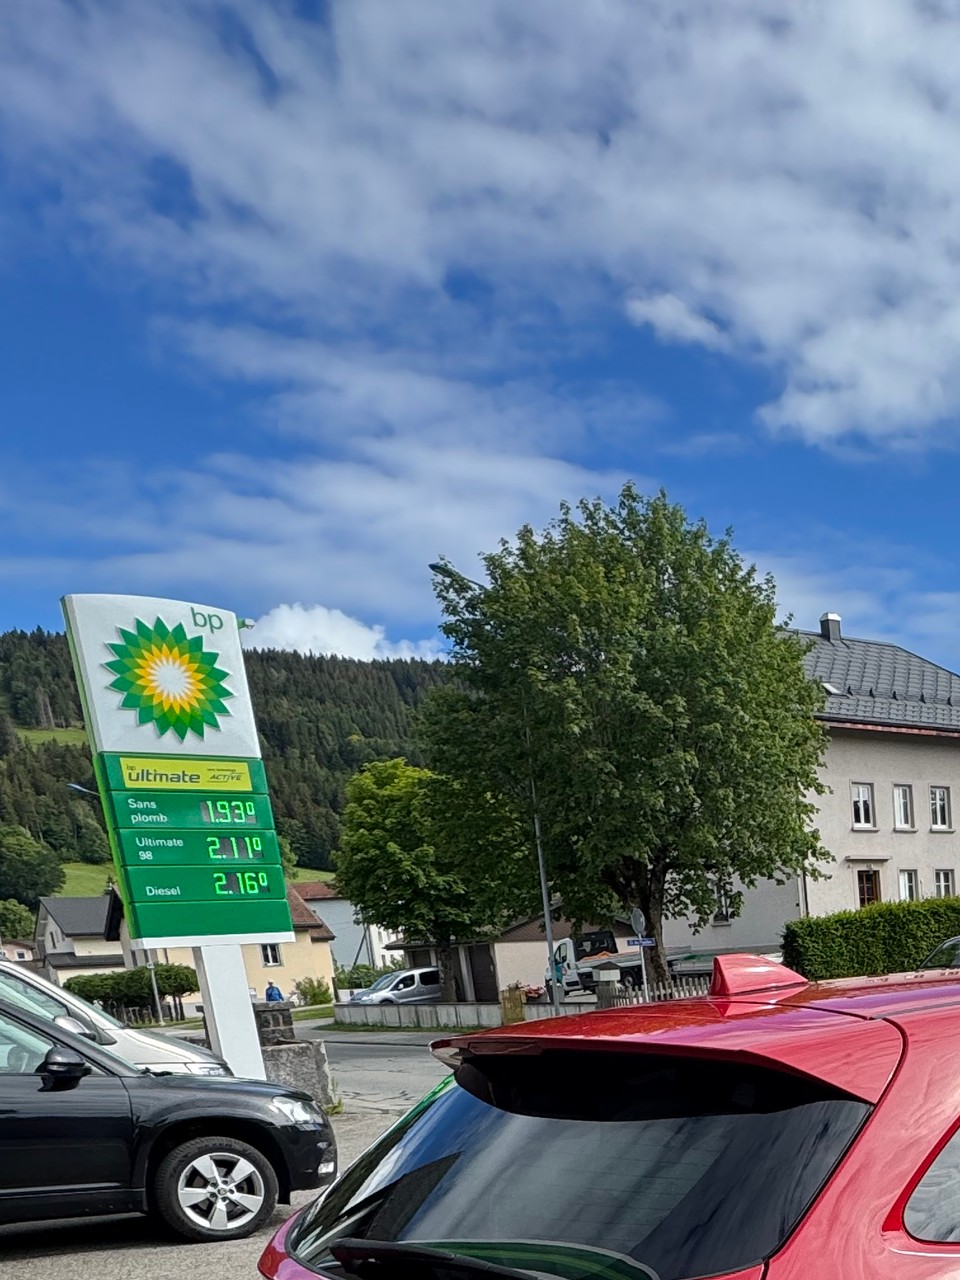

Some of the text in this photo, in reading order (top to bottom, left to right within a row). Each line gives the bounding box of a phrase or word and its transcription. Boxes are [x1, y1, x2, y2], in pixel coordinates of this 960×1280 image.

[190, 607, 224, 635] bp
[127, 768, 201, 784] ultimate
[209, 773, 243, 781] ACTIVE
[127, 798, 157, 809] Sans
[130, 812, 168, 825] plomb
[135, 837, 184, 847] Ultimate
[138, 851, 153, 861] 98
[145, 886, 181, 896] Diesel
